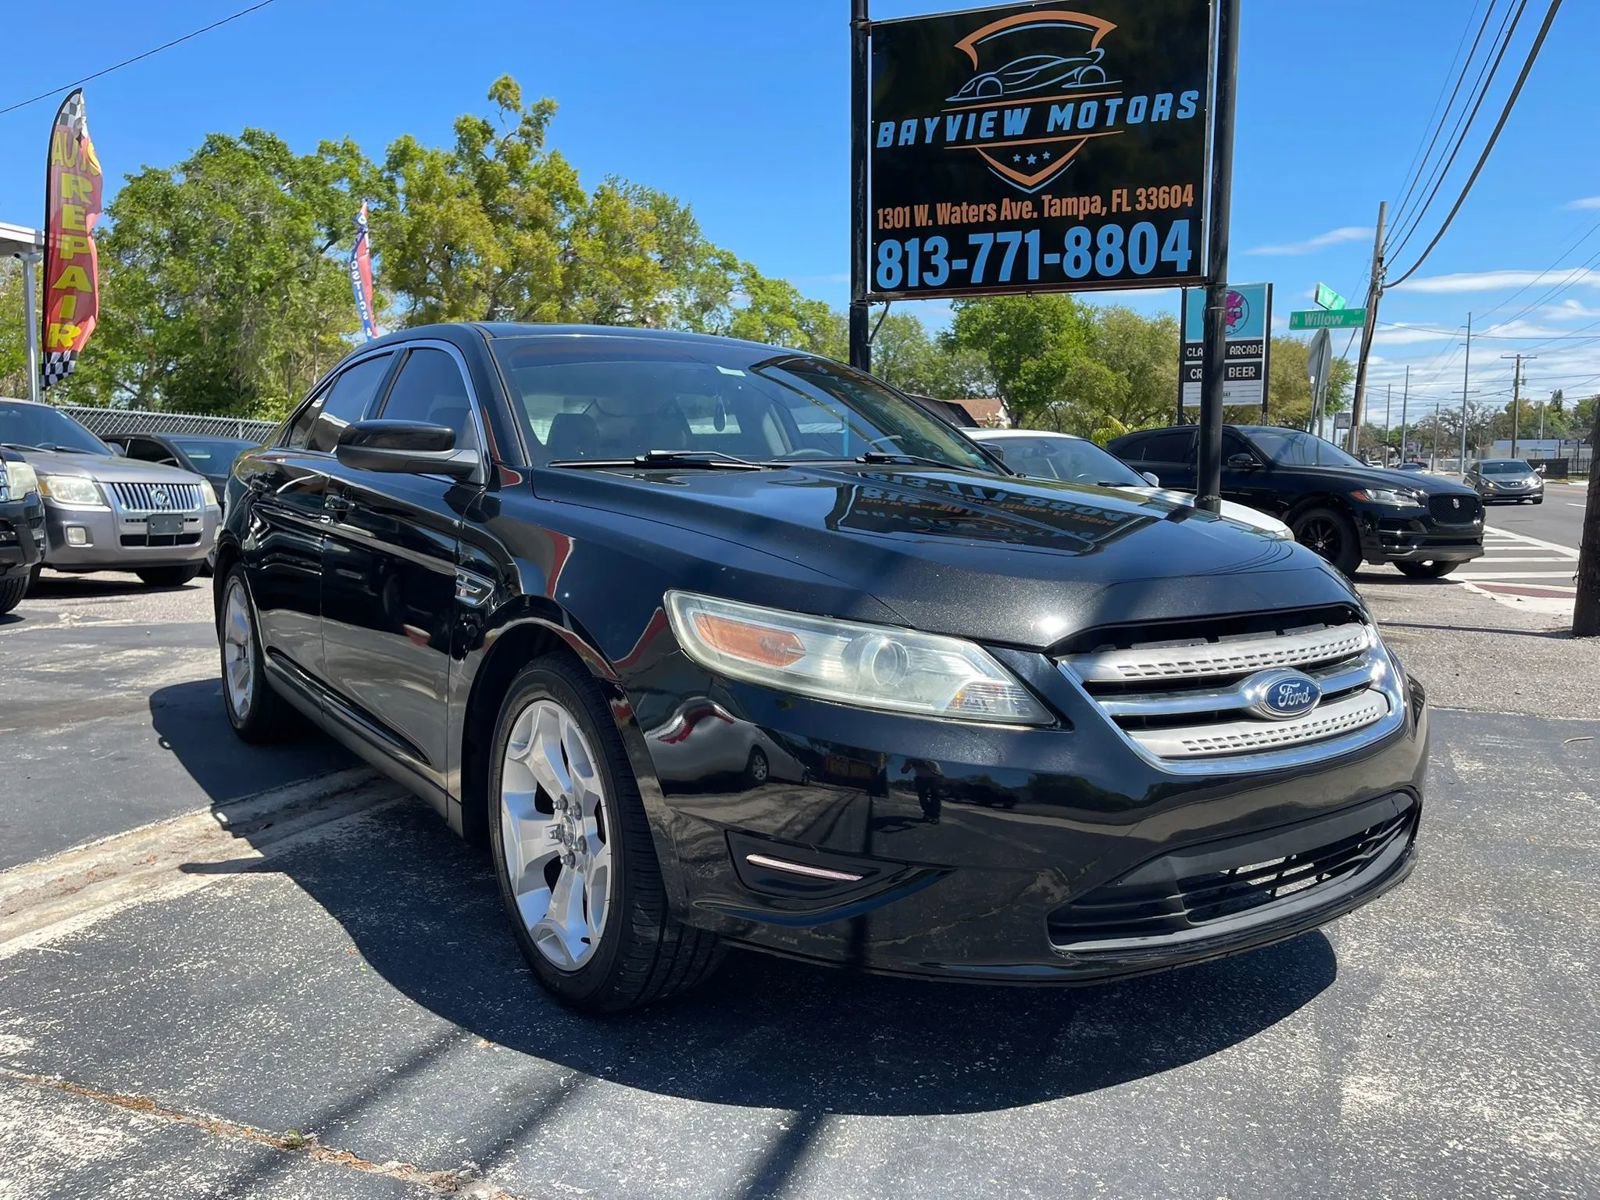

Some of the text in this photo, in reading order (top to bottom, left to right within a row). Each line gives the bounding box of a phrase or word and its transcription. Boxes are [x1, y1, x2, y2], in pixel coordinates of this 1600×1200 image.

[876, 90, 1200, 149] BAYVIEW MOTORS
[877, 183, 1194, 230] 1301 W. Waters Ave. Tampa, FL 33604
[48, 172, 94, 348] REPAIR
[875, 219, 1193, 290] 813-771-8804
[1304, 312, 1344, 326] Willow
[1229, 344, 1263, 356] ARCADE
[1228, 366, 1256, 378] BEER
[1278, 682, 1311, 707] Ford
